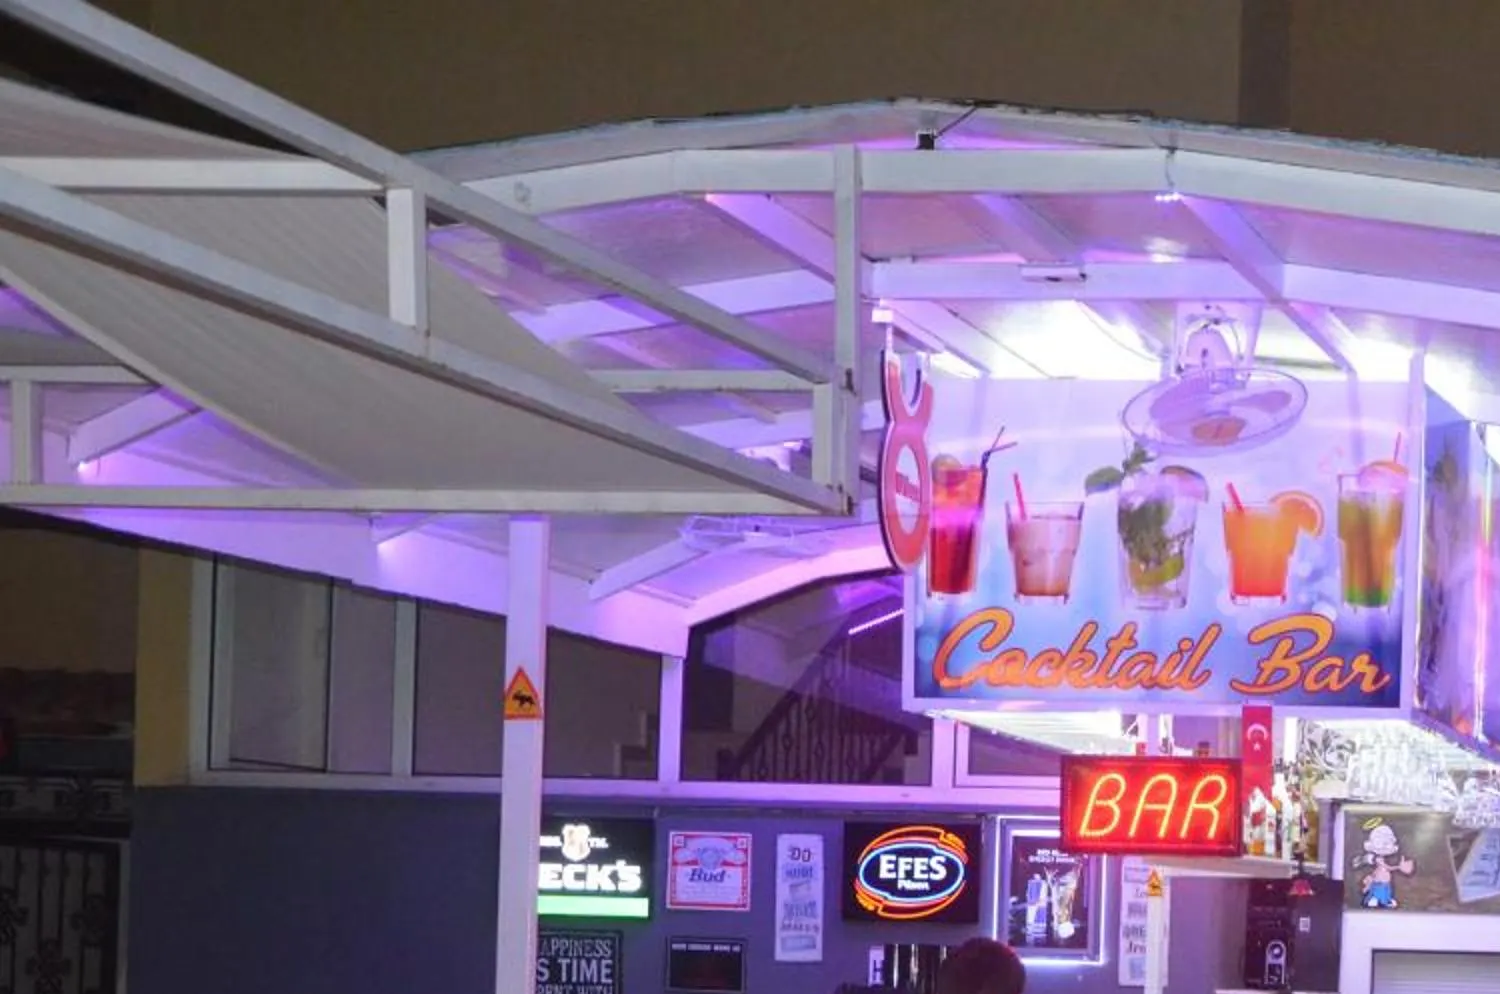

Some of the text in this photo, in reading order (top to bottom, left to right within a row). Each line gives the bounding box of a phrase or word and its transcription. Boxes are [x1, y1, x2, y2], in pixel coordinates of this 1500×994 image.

[932, 607, 1391, 695] Cocktail Bar
[1077, 773, 1230, 839] BAR
[538, 859, 642, 893] ECK'S
[688, 867, 726, 883] Bud
[878, 854, 948, 881] EFES
[541, 937, 612, 957] APPINESS
[537, 958, 613, 983] S TIME
